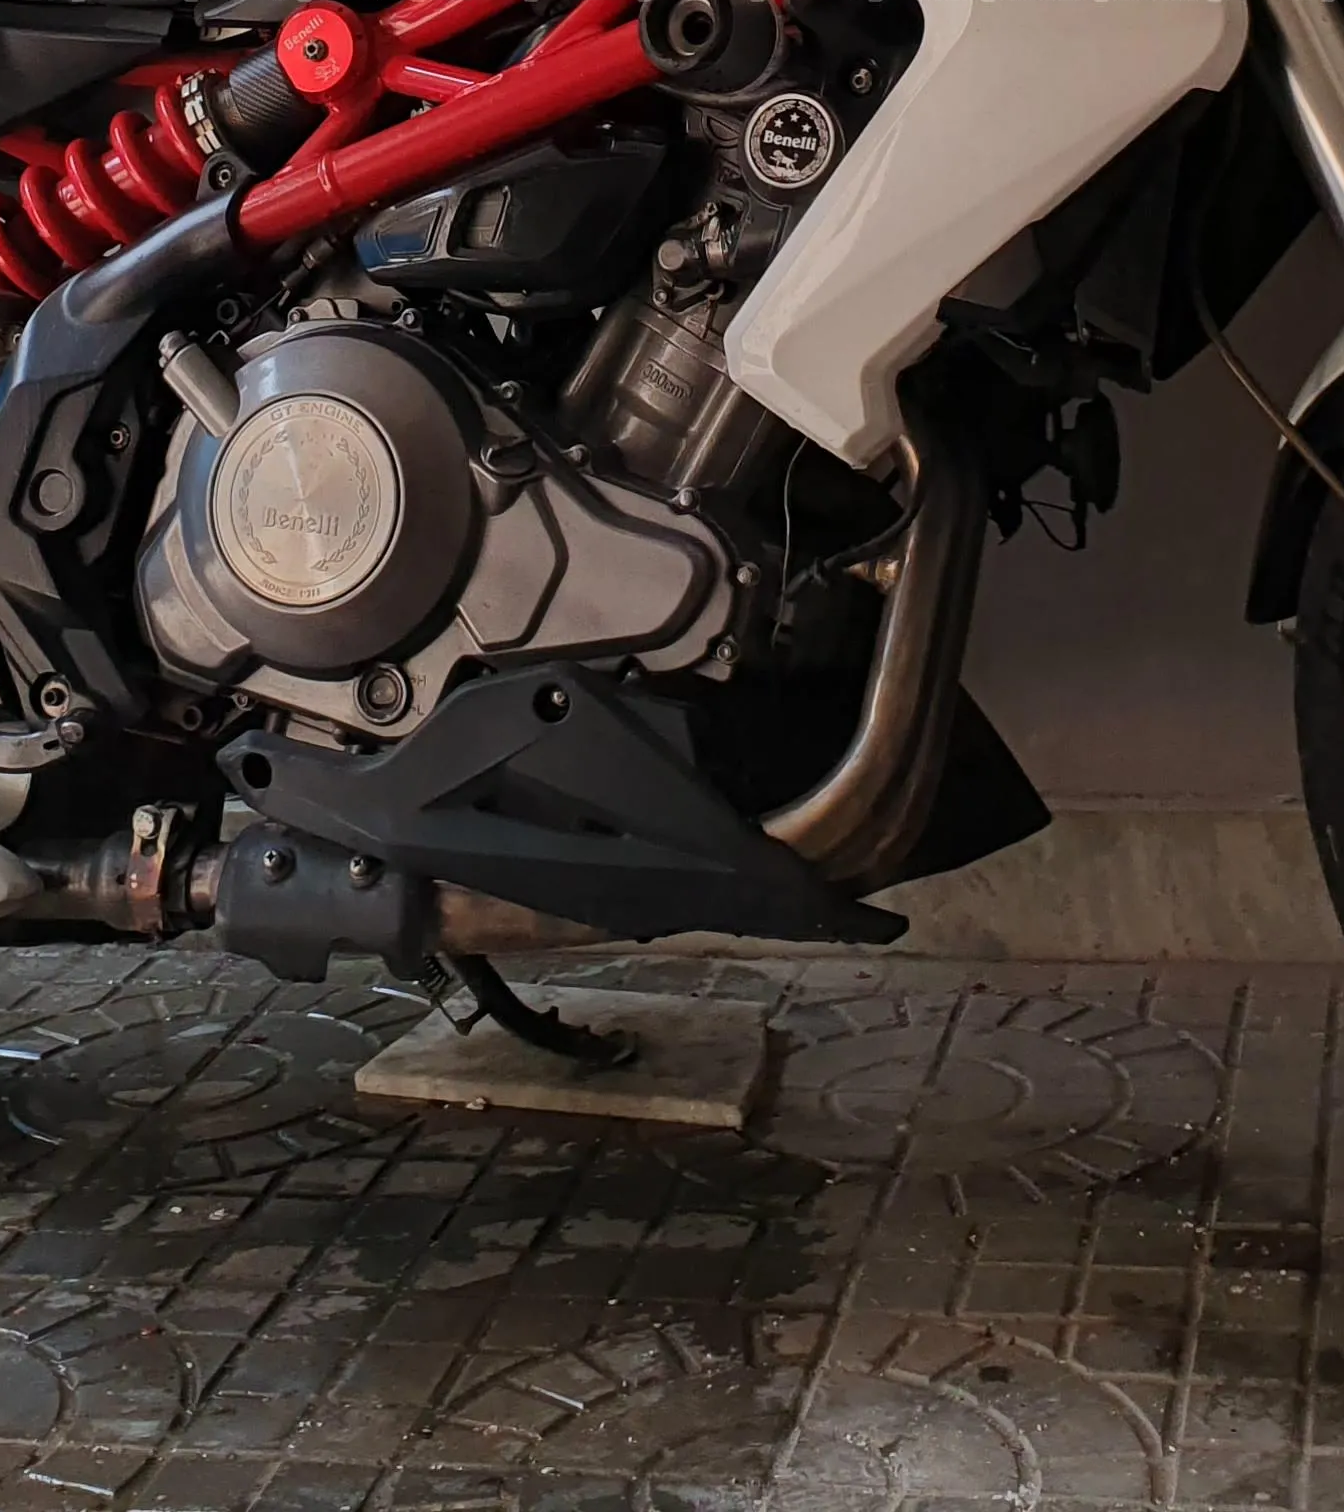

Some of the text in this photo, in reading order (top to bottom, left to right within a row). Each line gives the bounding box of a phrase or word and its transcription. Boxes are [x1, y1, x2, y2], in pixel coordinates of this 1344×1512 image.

[283, 14, 324, 50] Benelli
[762, 129, 817, 151] Benelli
[299, 402, 365, 434] ENGINE
[263, 506, 340, 537] Benelli
